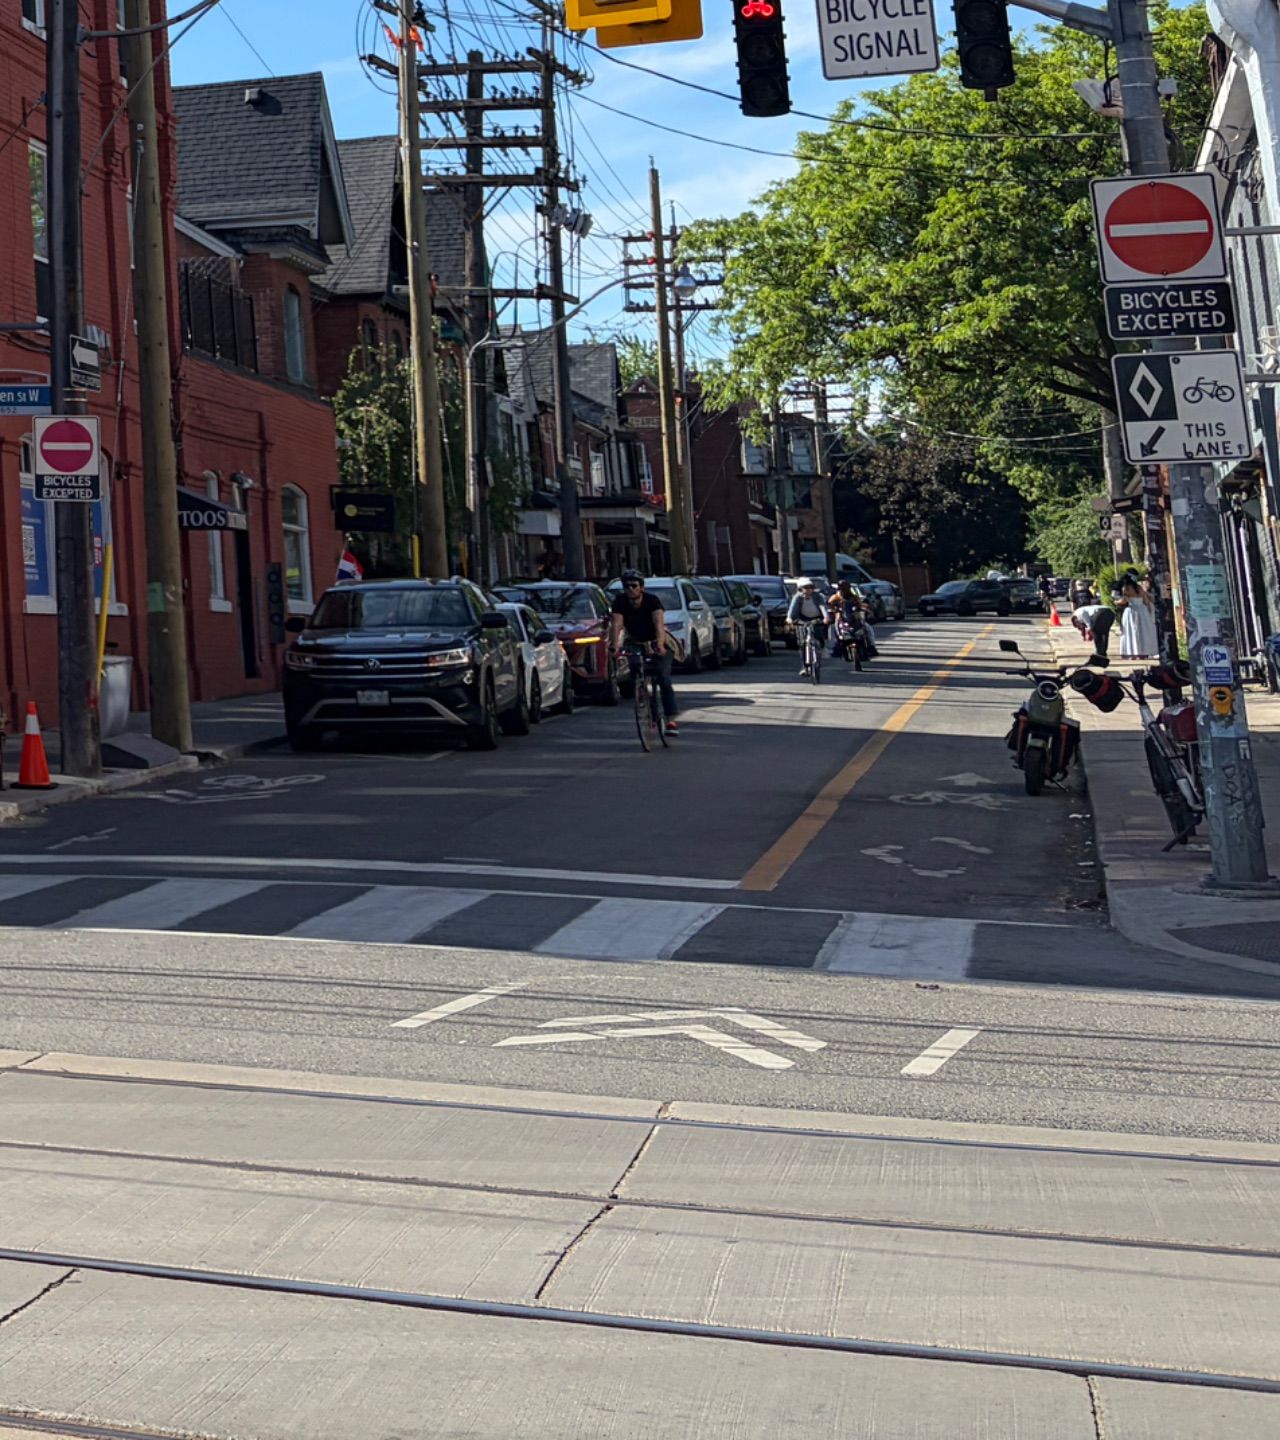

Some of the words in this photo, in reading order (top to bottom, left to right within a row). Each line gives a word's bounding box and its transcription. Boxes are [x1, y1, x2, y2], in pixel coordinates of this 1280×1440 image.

[834, 28, 927, 63] SIGNAL
[1120, 289, 1218, 311] BICYCLES
[1117, 311, 1226, 332] EXCEPTED
[17, 391, 27, 402] St
[28, 389, 39, 402] W
[1184, 422, 1226, 438] THIS
[1183, 440, 1232, 458] LANE
[43, 476, 91, 486] BICYCLES
[42, 488, 93, 499] EXCEPTED
